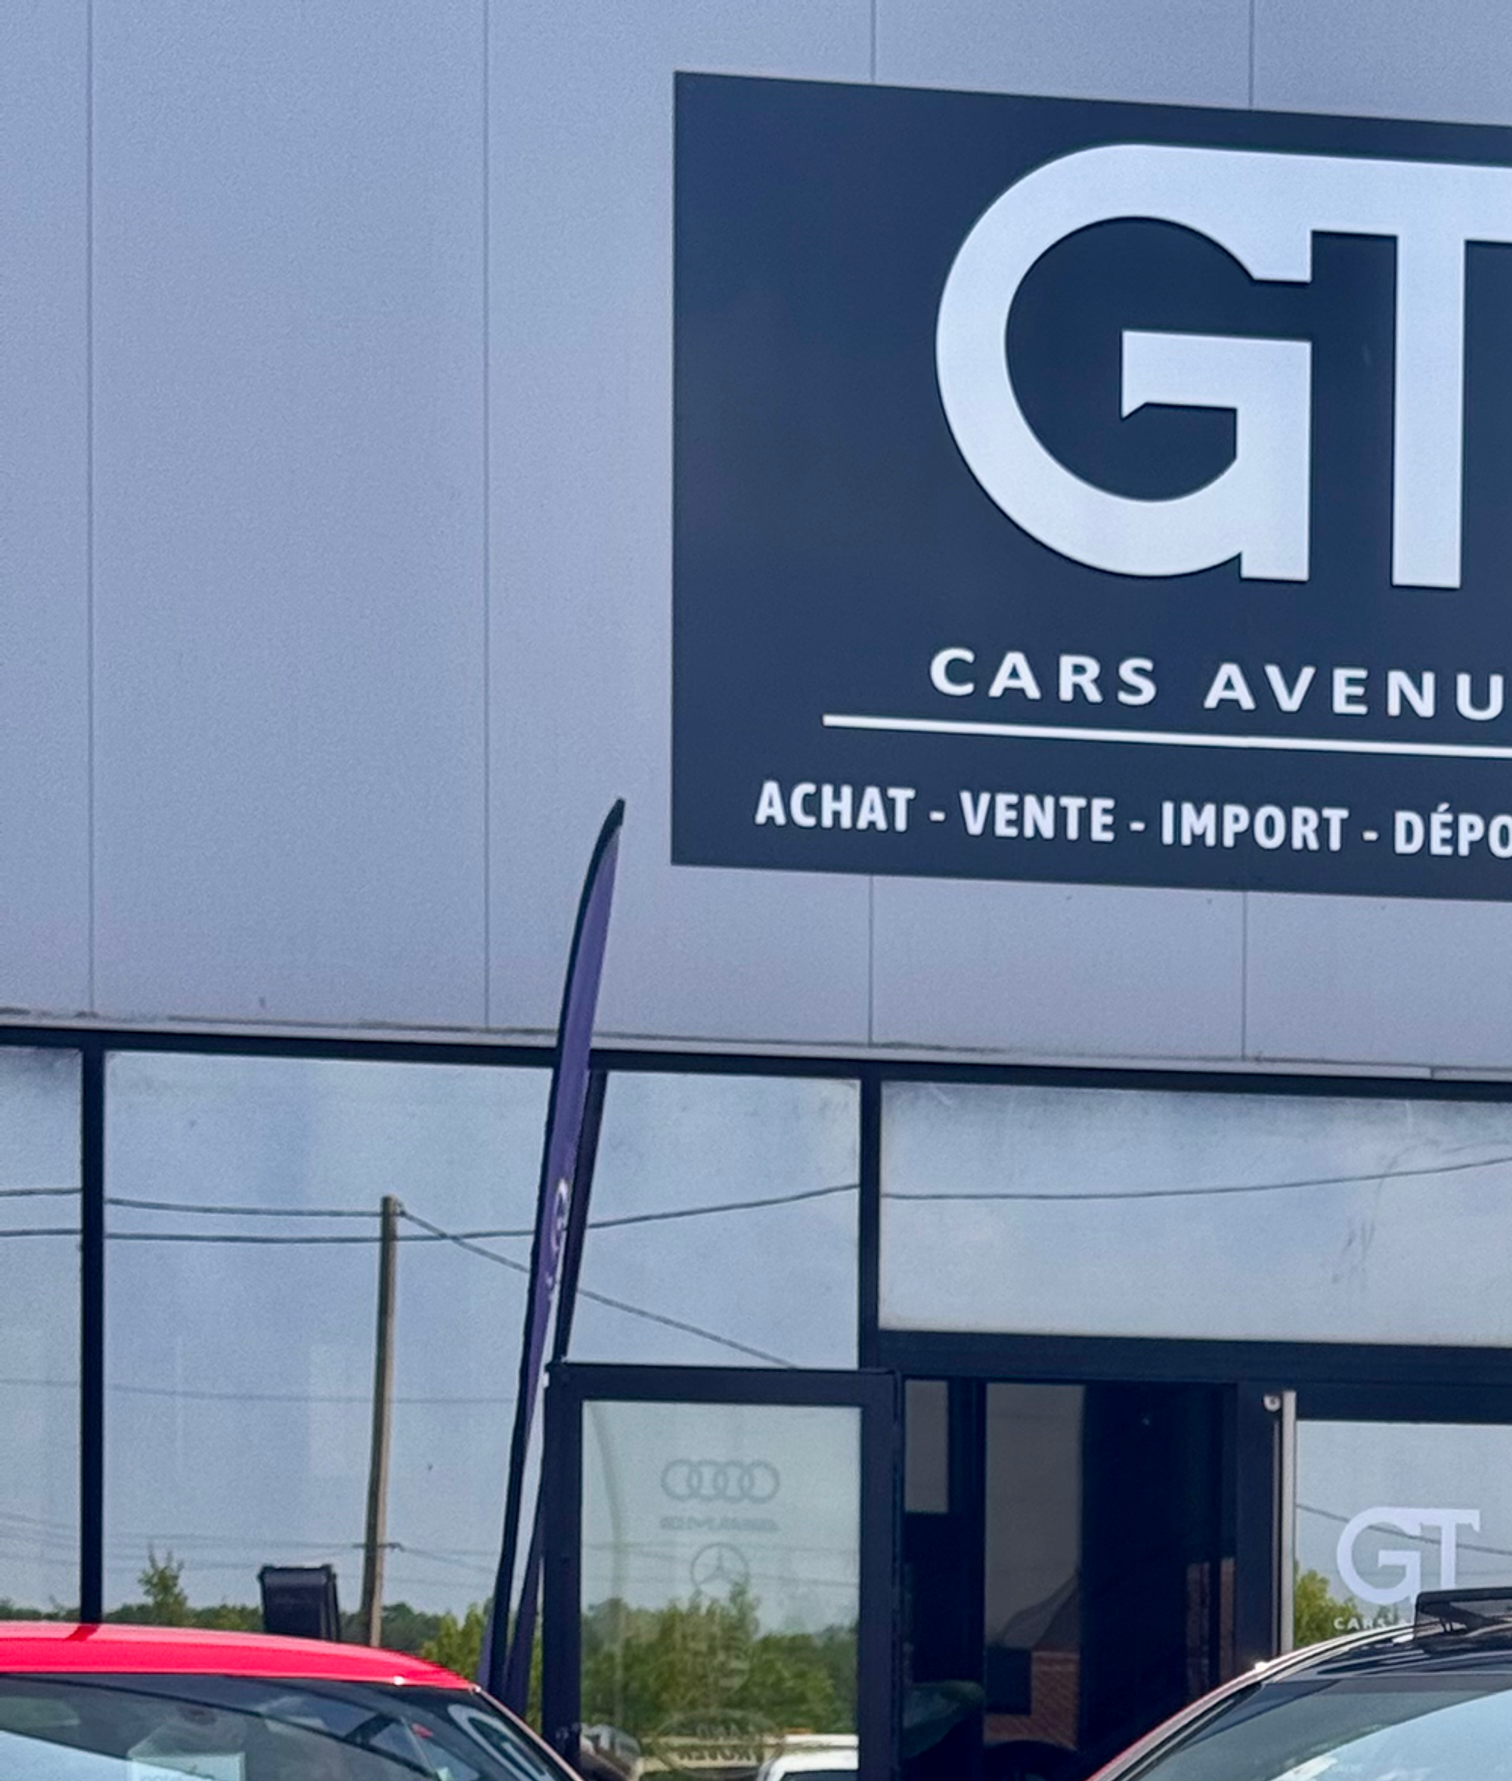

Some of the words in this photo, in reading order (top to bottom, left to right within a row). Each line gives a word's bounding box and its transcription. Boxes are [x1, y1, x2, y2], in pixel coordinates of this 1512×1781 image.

[930, 648, 1155, 706] CARS
[755, 781, 915, 832] ACHAT
[960, 791, 1115, 842] VENTE
[1162, 802, 1348, 851] IMPORT
[1336, 1506, 1480, 1606] GT
